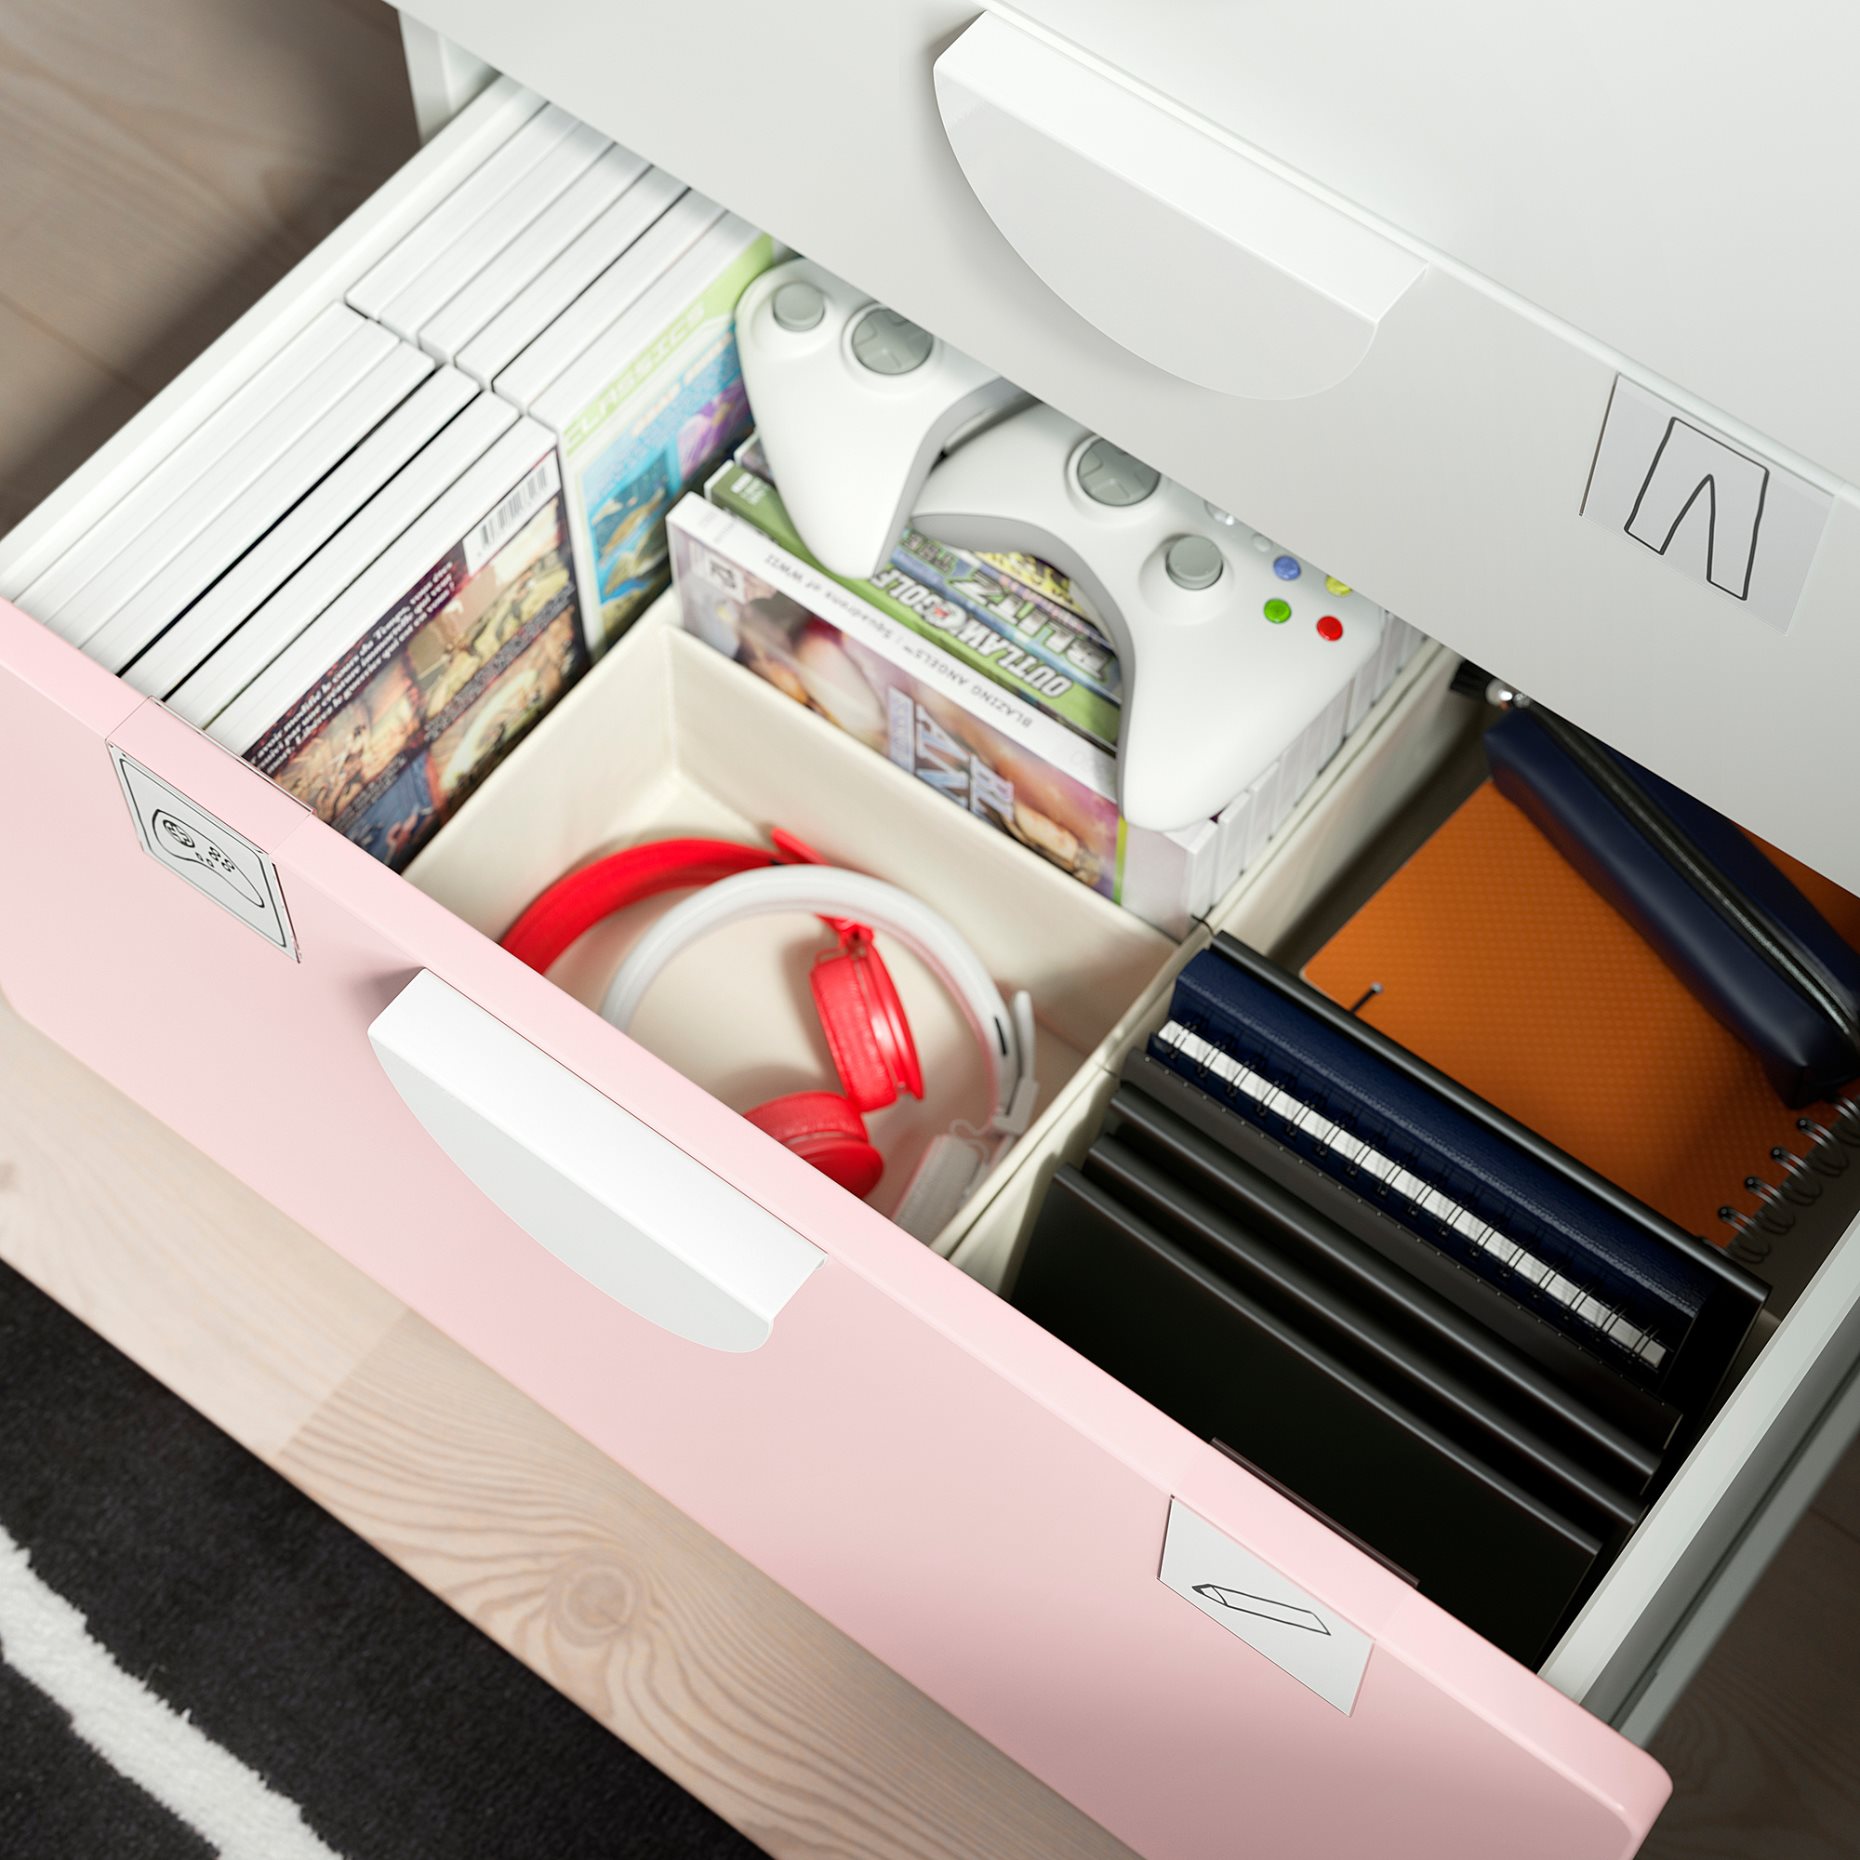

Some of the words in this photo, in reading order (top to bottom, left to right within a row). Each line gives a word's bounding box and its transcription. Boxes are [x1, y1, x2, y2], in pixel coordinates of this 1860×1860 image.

[764, 552, 805, 583] WWII
[900, 527, 955, 573] THE
[804, 577, 822, 594] of
[868, 559, 941, 618] GOLF
[823, 589, 893, 640] Squadrons
[947, 560, 1110, 678] BLITZ
[949, 612, 1073, 701] OUTLAW
[969, 683, 1033, 728] BLAZING
[255, 728, 283, 759] avoir
